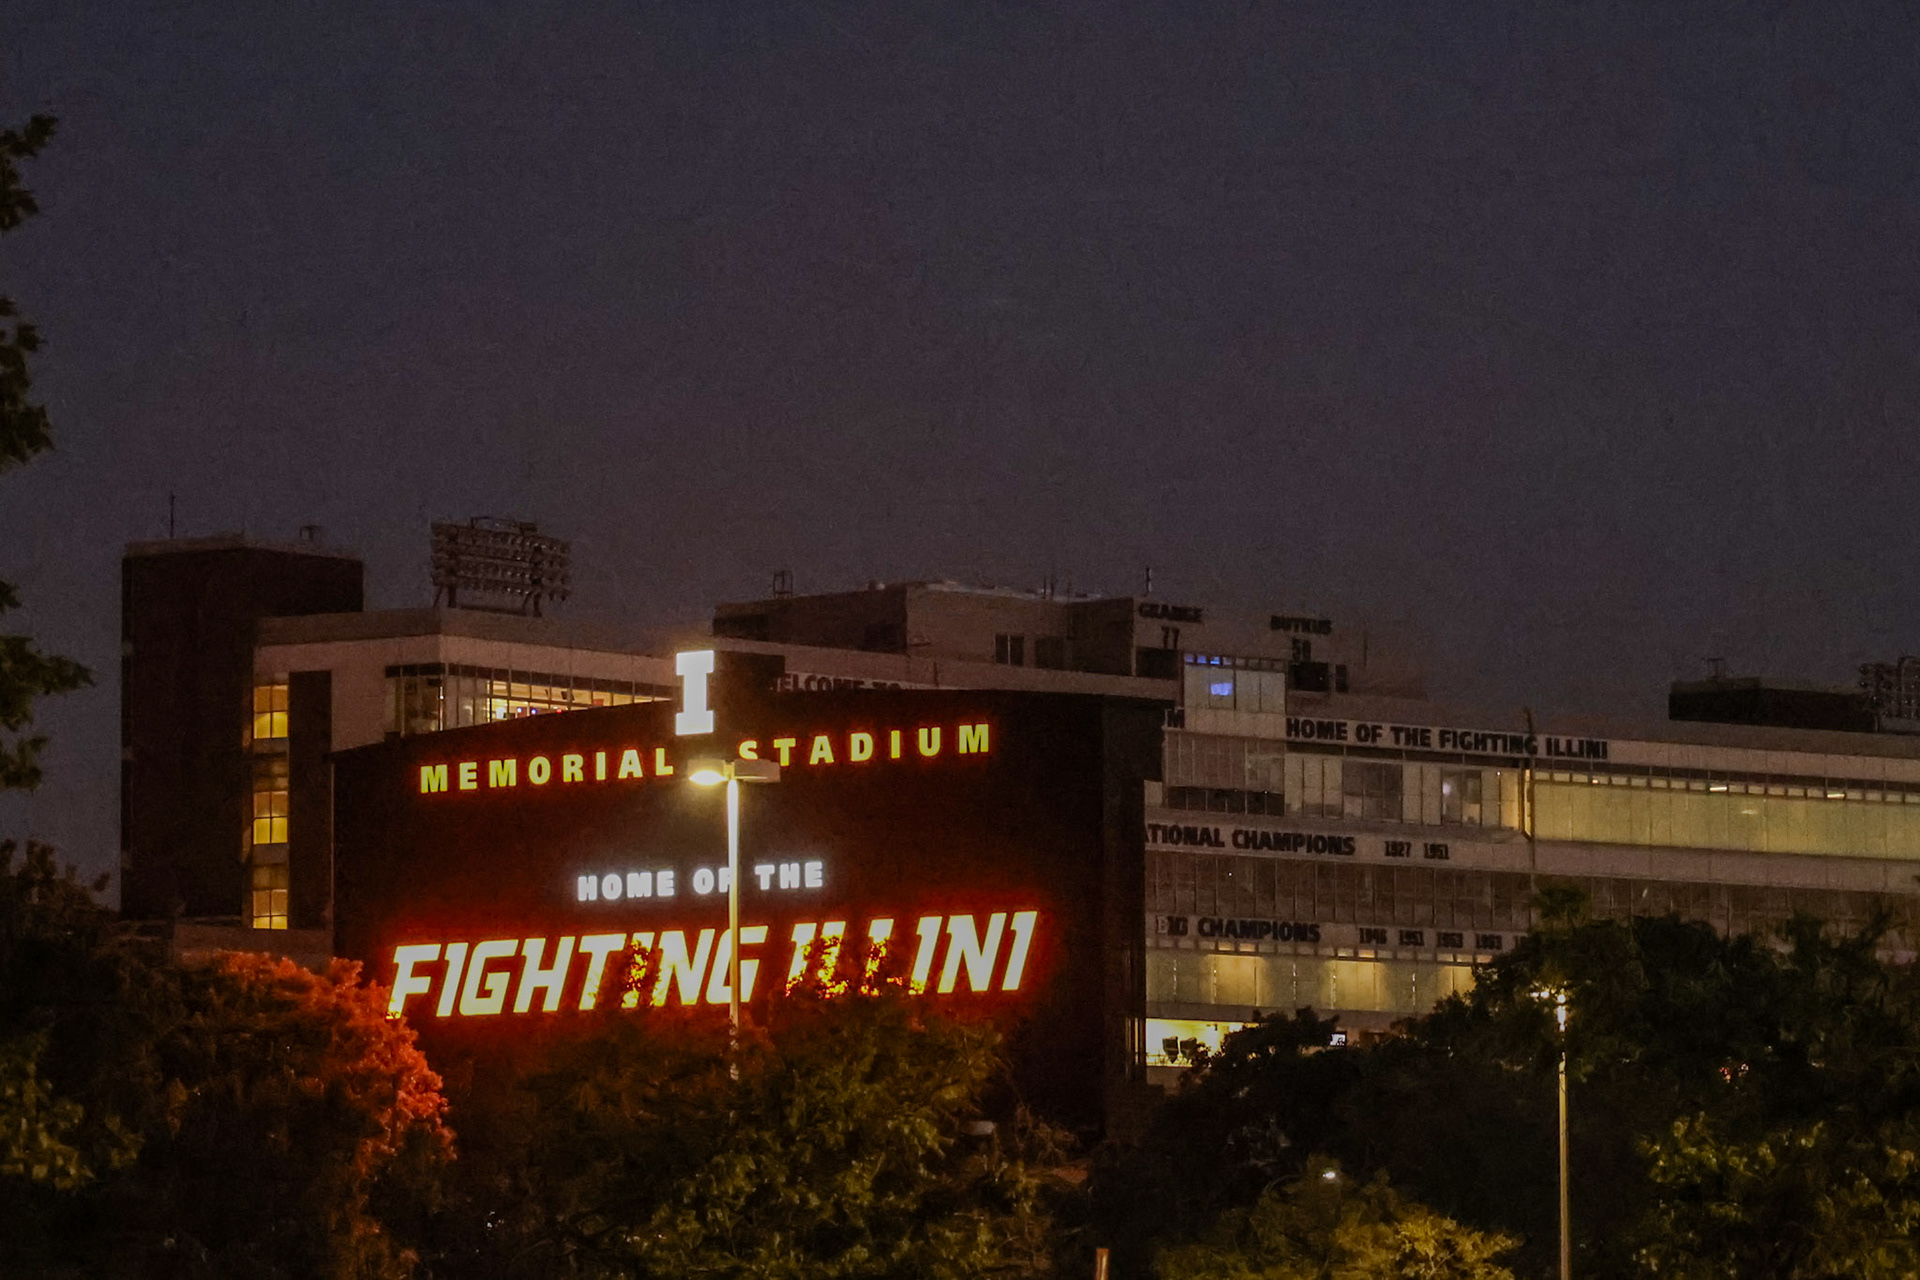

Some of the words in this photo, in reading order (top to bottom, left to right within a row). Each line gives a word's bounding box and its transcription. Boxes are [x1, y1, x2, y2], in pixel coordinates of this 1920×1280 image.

[420, 748, 673, 793] MEMORIAL
[739, 724, 989, 766] STADIUM
[1286, 717, 1348, 741] HOME
[1355, 723, 1383, 744] OF
[1390, 726, 1431, 748] THE
[1439, 729, 1538, 756] FIGHTING
[1545, 737, 1608, 760] ILLINI
[1144, 823, 1225, 848] TIONAL
[1231, 828, 1356, 857] CHAMPIONS
[1384, 840, 1411, 858] 1927
[577, 869, 675, 901] HOME
[754, 861, 823, 891] THE
[1198, 916, 1321, 942] CHAMPIONS
[386, 925, 769, 1020] FIGHTING
